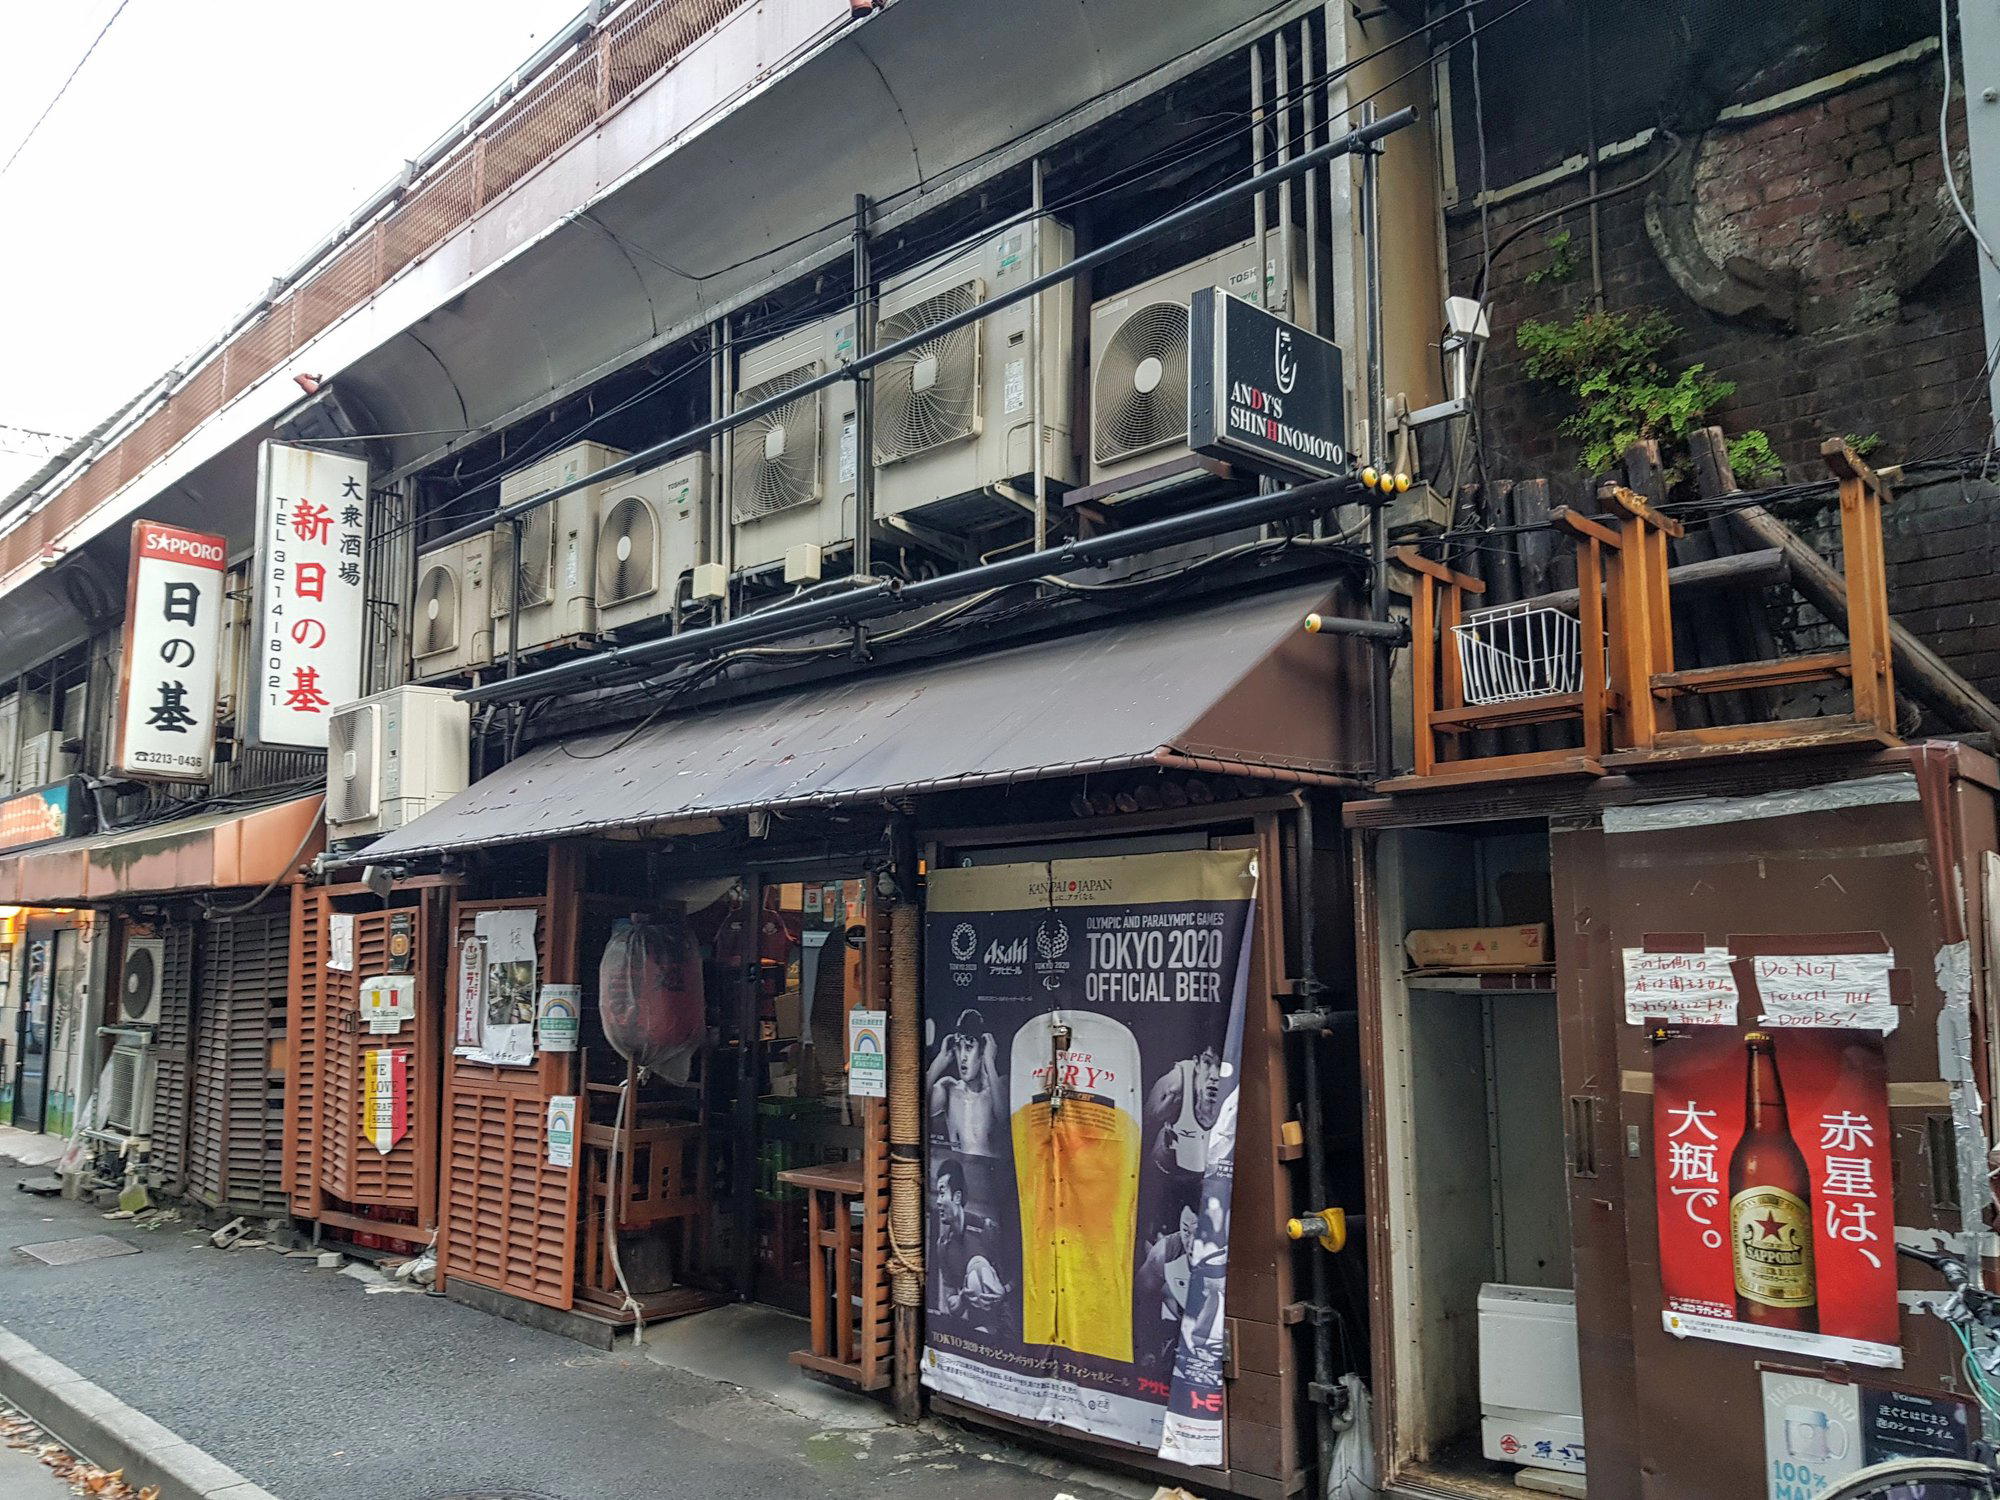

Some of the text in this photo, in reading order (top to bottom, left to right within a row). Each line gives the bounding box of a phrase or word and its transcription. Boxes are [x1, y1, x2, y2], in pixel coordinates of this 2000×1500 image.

[1230, 381, 1283, 419] ANDY'S
[1230, 405, 1343, 465] SHINHINOMOTO
[275, 497, 288, 542] TEL
[338, 476, 364, 586] 大衆酒場
[283, 498, 334, 713] 新日の基
[145, 581, 201, 734] 日の基
[1078, 879, 1112, 893] JAPAN
[1086, 912, 1224, 930] OLYMPIC AND PARALYMPIC GAMES
[983, 937, 1029, 964] Asahi
[1086, 929, 1223, 970] TOKYO 2020
[1085, 971, 1220, 1002] OFFICIAL BEER
[371, 1064, 387, 1075] WE
[1058, 1051, 1092, 1063] SUPER
[370, 1081, 399, 1093] LOVE
[1668, 1100, 1722, 1249] 大瓶で。
[1819, 1110, 1882, 1269] 赤星は、
[1745, 1245, 1803, 1265] SAPPORO
[931, 1331, 962, 1348] TOKYO
[1767, 1381, 1856, 1421] HEARTLAND
